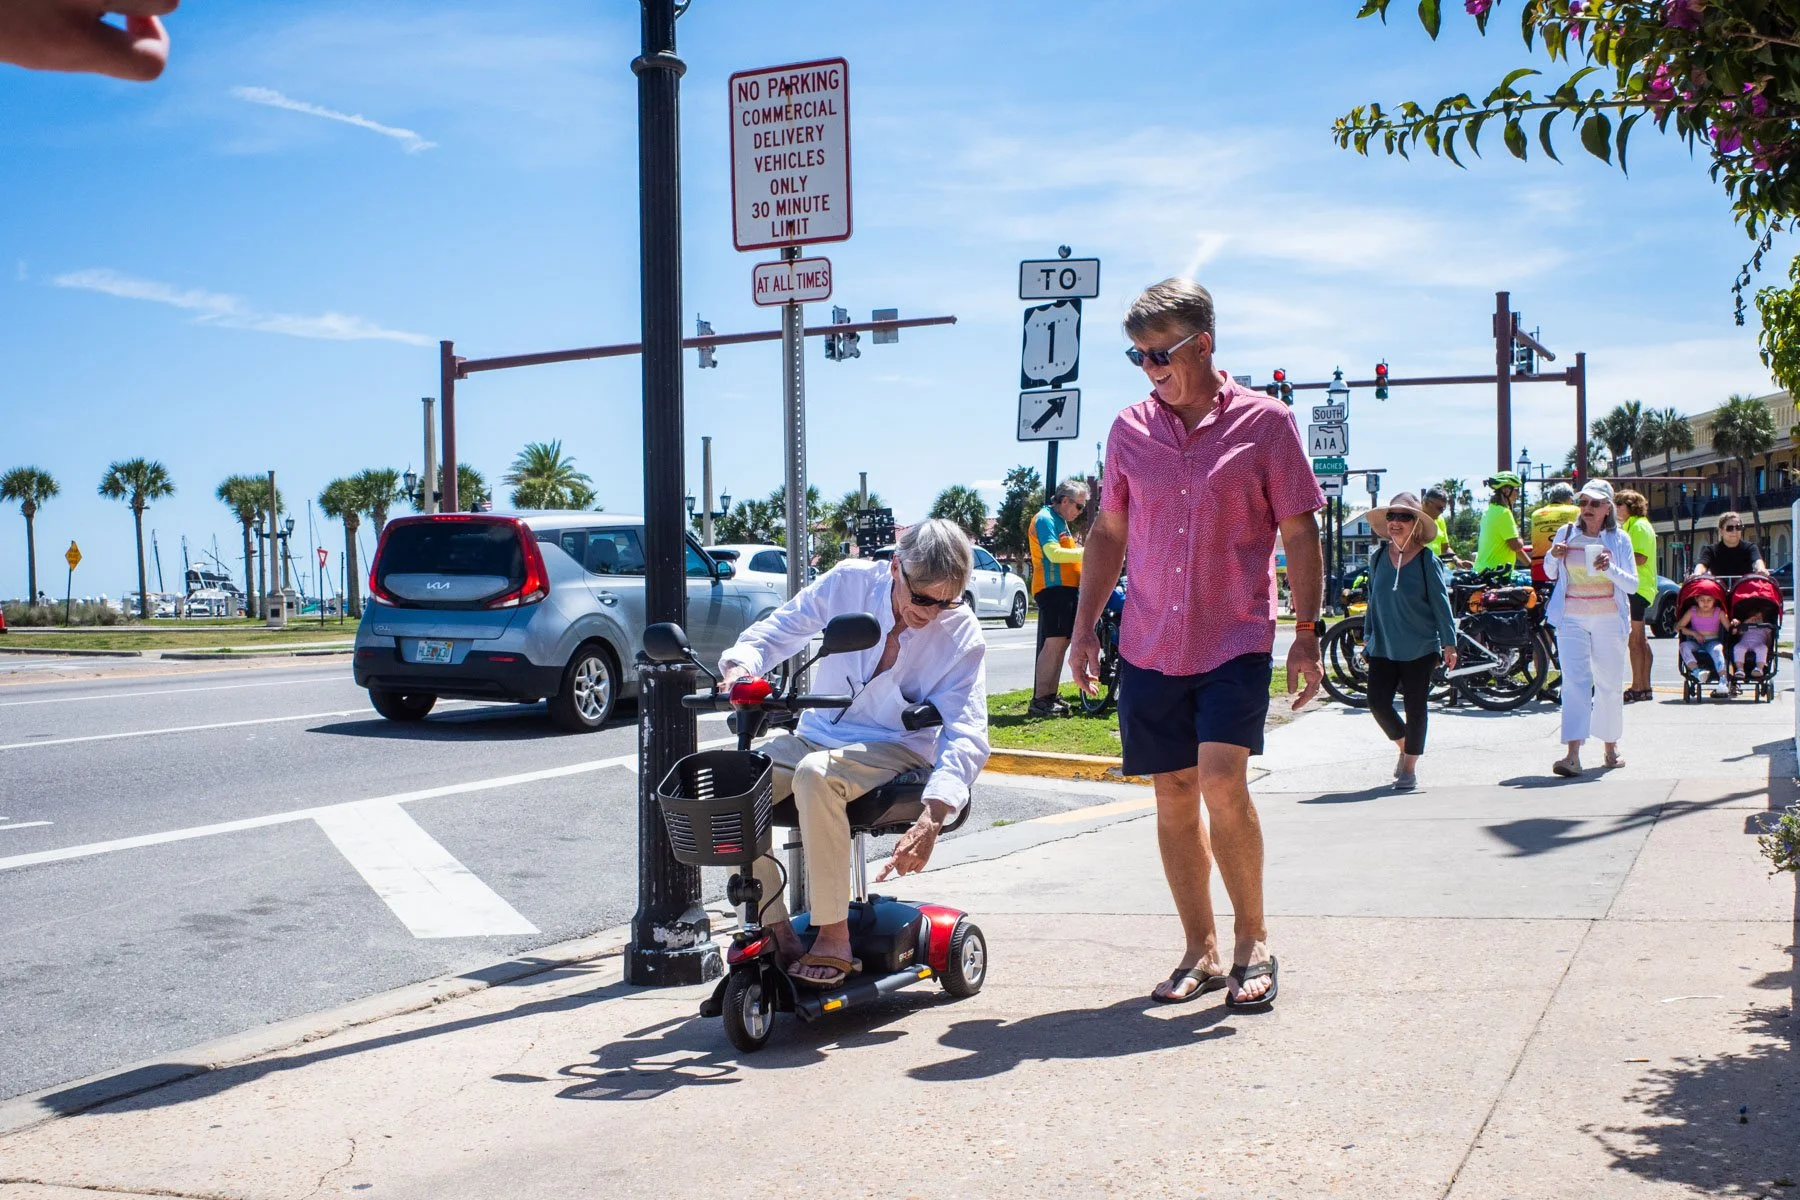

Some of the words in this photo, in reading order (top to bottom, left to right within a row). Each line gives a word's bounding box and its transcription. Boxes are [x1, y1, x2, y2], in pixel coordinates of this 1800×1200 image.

[738, 80, 760, 103] NO
[768, 69, 839, 99] PARKING
[742, 99, 837, 127] COMMERCIAL
[753, 124, 825, 149] DELIVERY
[754, 149, 825, 173] VEHICLES
[770, 175, 808, 195] ONLY
[751, 202, 770, 219] 30
[776, 194, 830, 216] MINUTE
[771, 218, 809, 238] LIMIT
[757, 276, 769, 294] AT
[773, 273, 794, 292] ALL
[796, 270, 829, 290] TIMES
[1040, 267, 1077, 290] TO
[1047, 320, 1056, 364] 1
[1314, 408, 1343, 420] SOUTH
[1314, 437, 1337, 450] A1A
[1314, 462, 1342, 470] BEACHES
[426, 581, 450, 590] KIA
